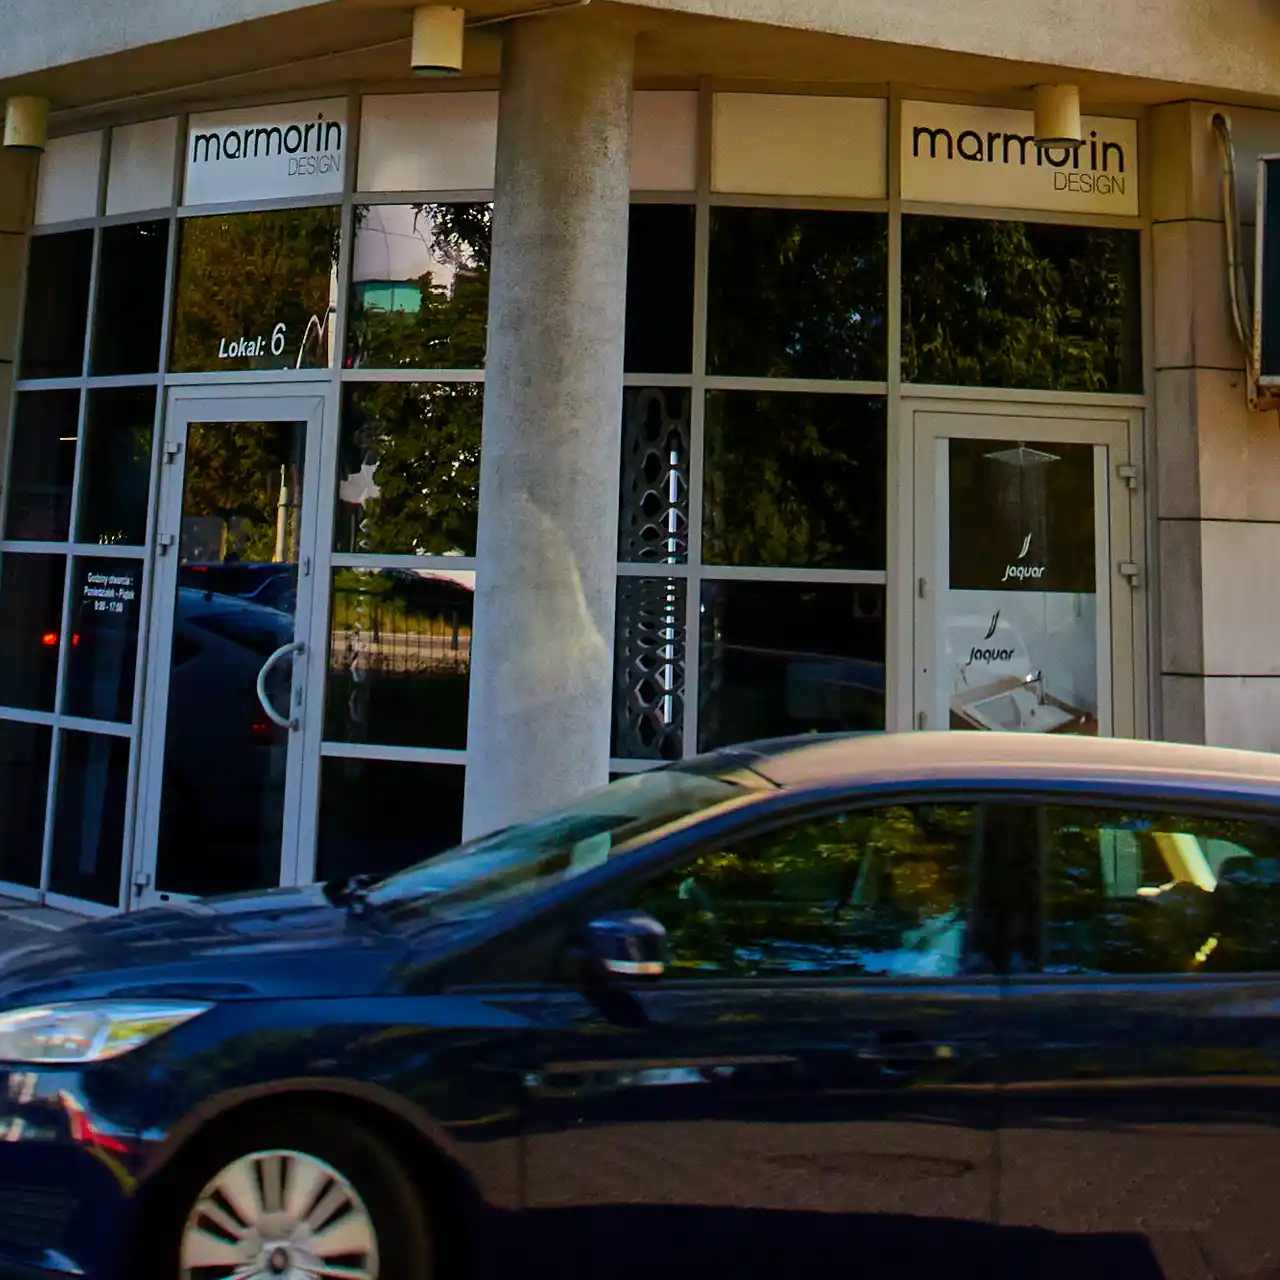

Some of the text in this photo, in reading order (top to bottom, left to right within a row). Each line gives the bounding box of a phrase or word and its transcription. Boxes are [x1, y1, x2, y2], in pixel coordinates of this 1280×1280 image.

[193, 112, 341, 162] marmorin
[913, 126, 1124, 172] marmorin
[287, 154, 341, 176] DESIGN
[1053, 171, 1125, 194] DESIGN
[218, 323, 286, 358] Lokal: 6
